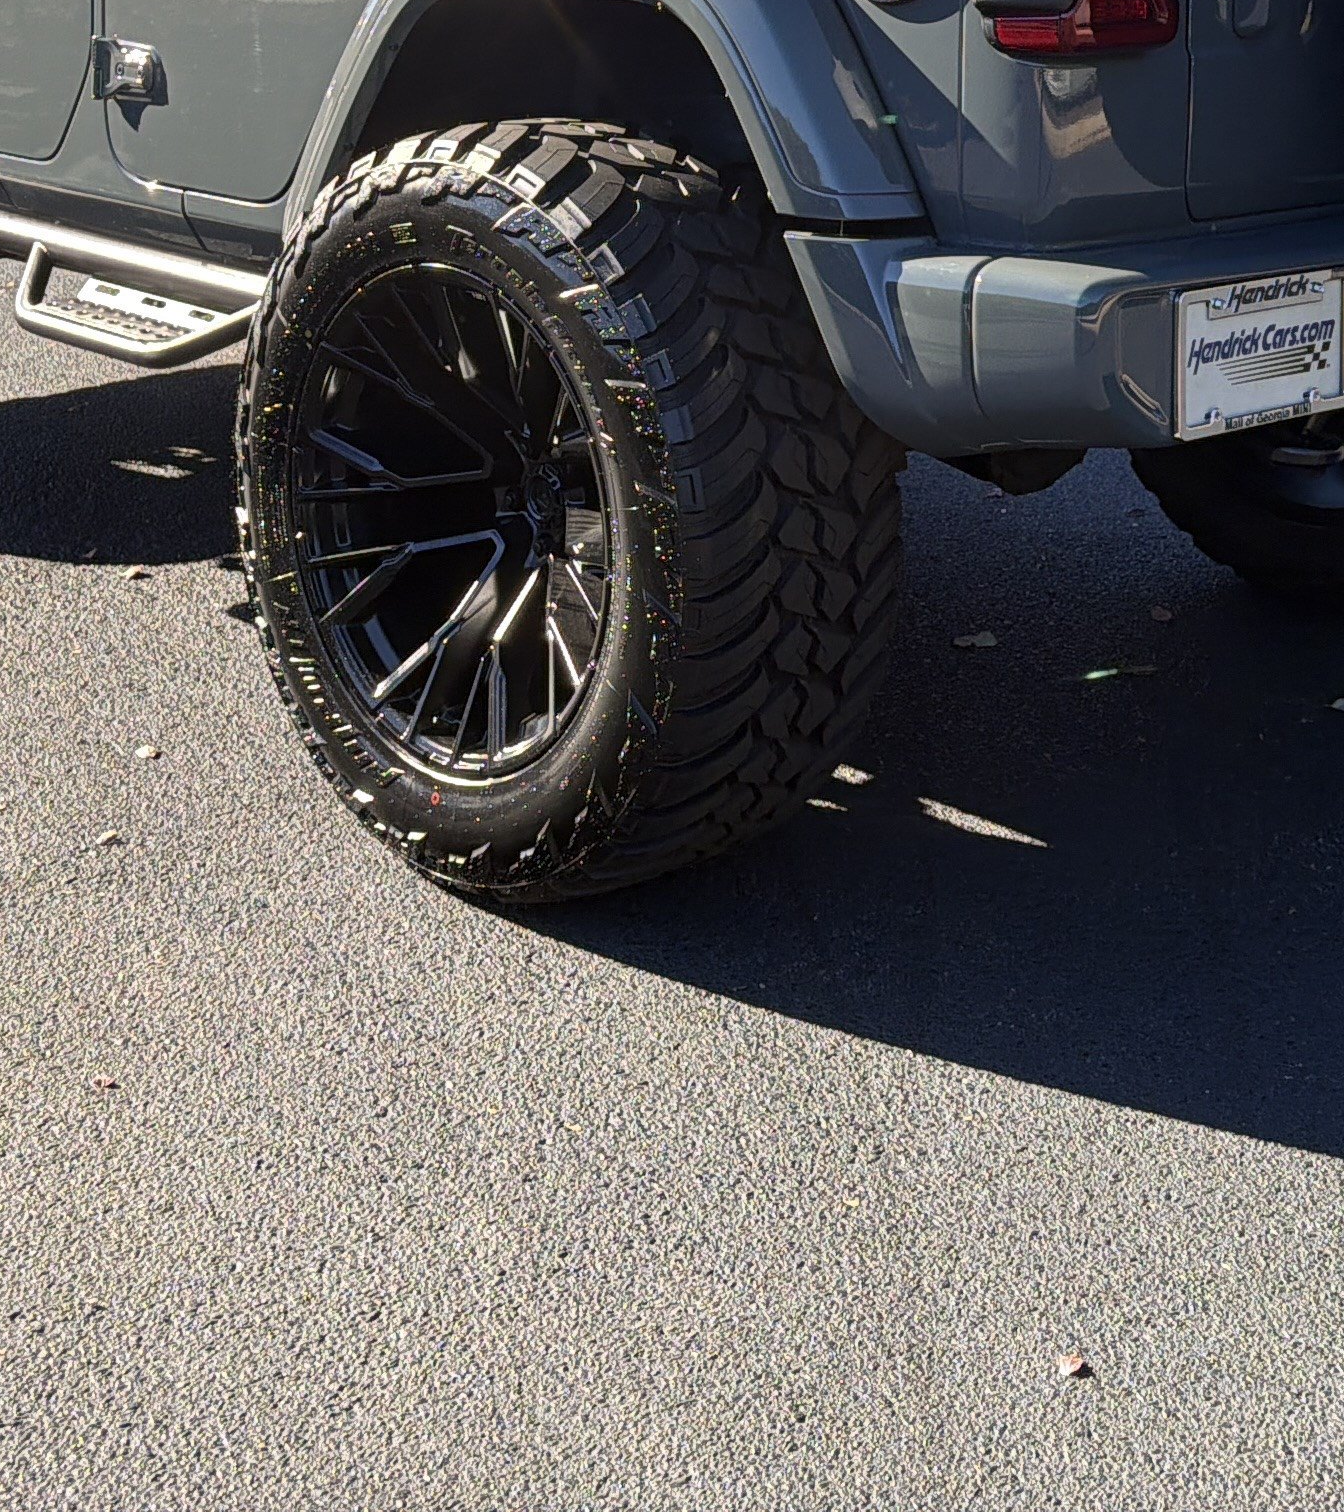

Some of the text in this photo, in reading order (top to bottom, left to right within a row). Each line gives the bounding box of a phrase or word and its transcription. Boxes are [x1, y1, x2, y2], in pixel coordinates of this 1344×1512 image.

[1224, 274, 1309, 313] Hendrick
[1224, 416, 1244, 431] Mall
[1245, 414, 1255, 426] of
[1256, 408, 1290, 424] Georgia
